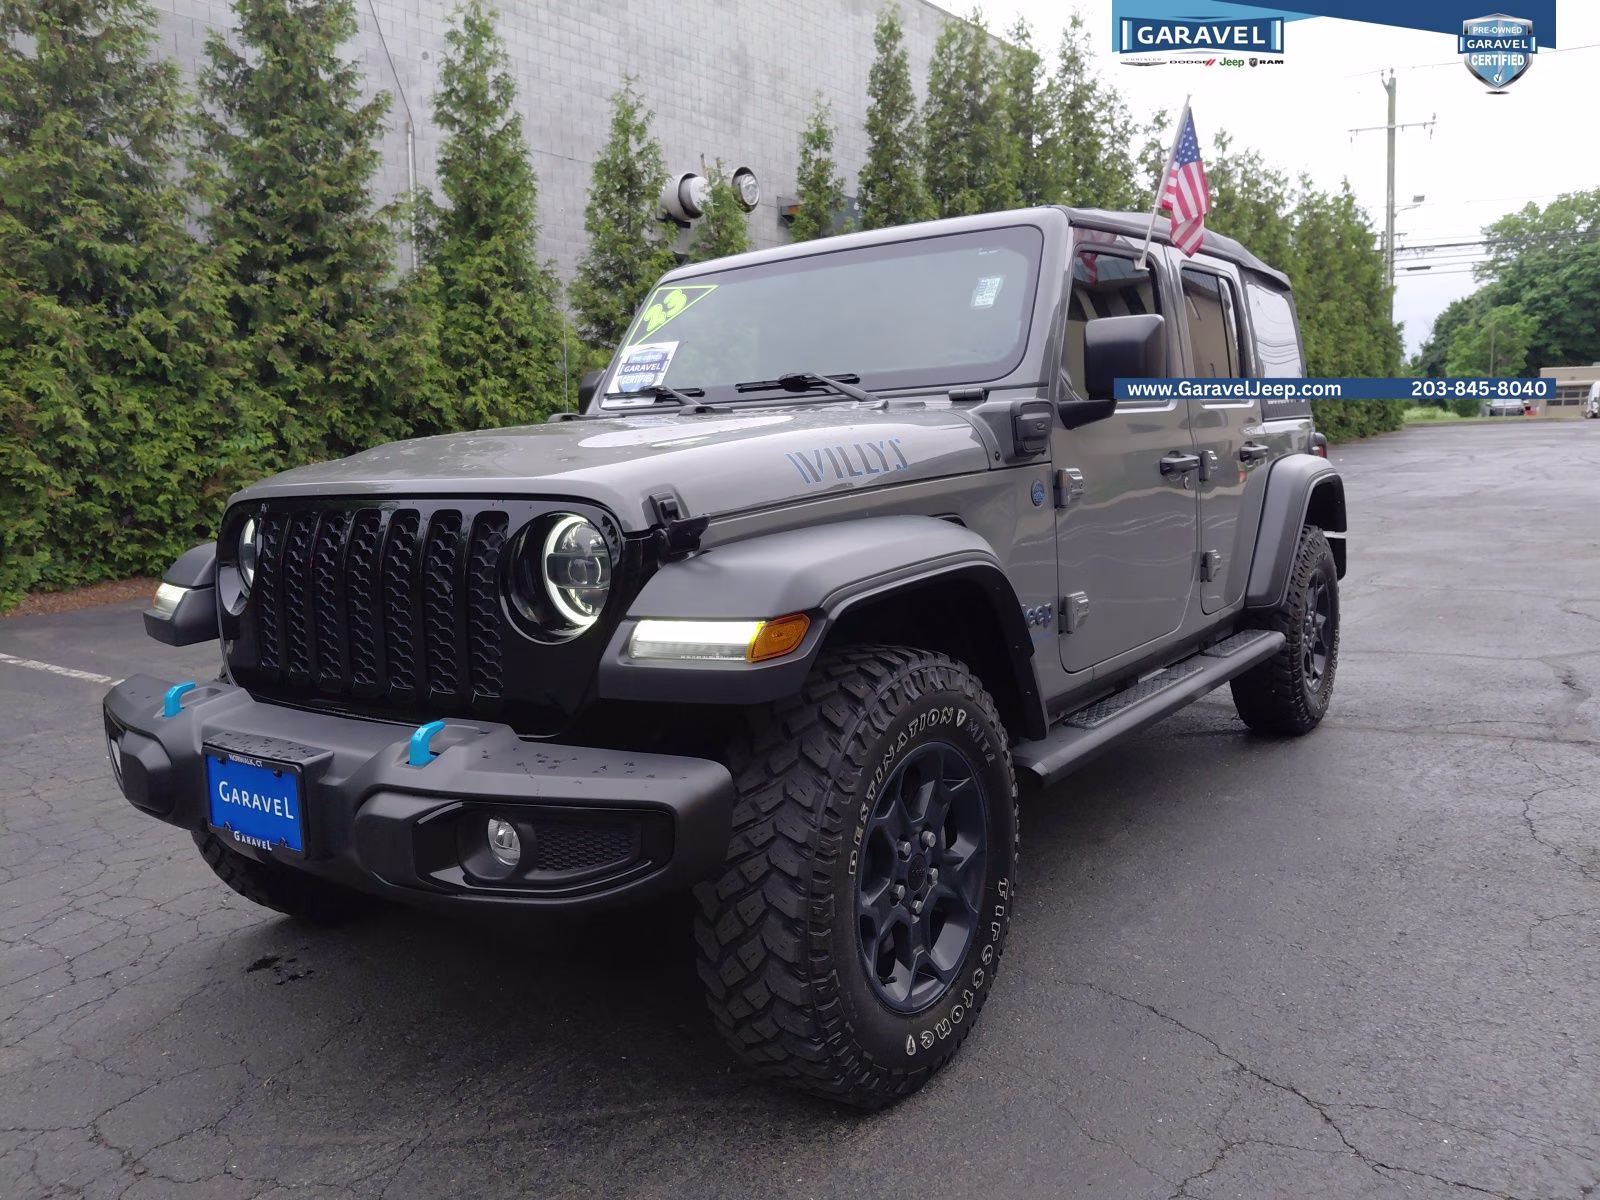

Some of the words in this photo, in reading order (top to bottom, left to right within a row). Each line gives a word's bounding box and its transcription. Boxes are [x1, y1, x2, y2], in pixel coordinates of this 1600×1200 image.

[624, 362, 661, 373] GARAVEL
[784, 437, 908, 485] WILLYS
[218, 780, 295, 820] GARAVEL
[848, 706, 954, 875] DESTINATION
[233, 830, 273, 852] GARAVEL
